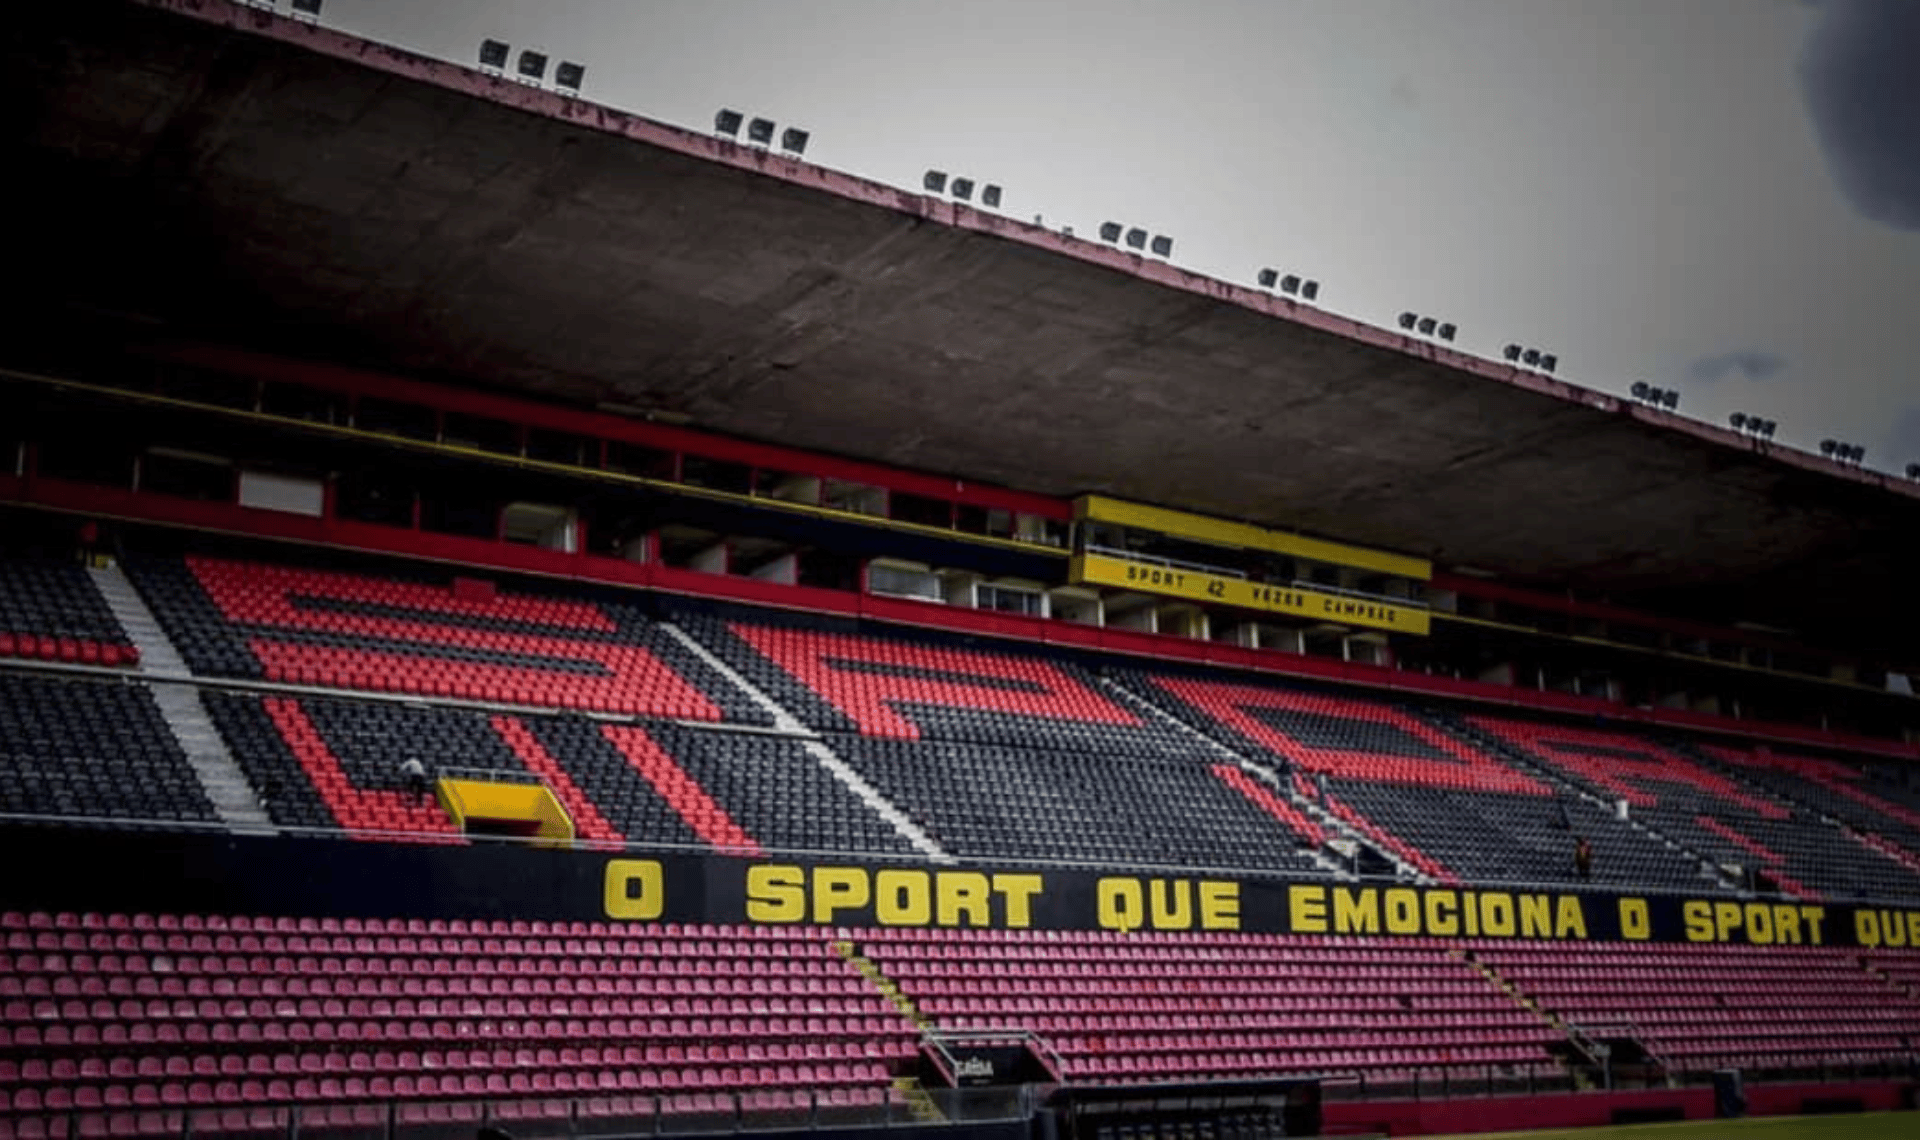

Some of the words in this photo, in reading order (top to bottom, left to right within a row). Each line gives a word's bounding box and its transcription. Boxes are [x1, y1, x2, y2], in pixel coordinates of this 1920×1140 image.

[1127, 565, 1185, 588] SPORT
[1206, 580, 1226, 599] 42
[604, 859, 663, 920] O
[746, 864, 1043, 928] SPORT
[1096, 876, 1240, 935] QUE
[1288, 885, 1588, 938] EMOCIONA
[1619, 898, 1650, 940] O
[1684, 901, 1823, 945] SPORT
[1855, 910, 1920, 947] QUE
